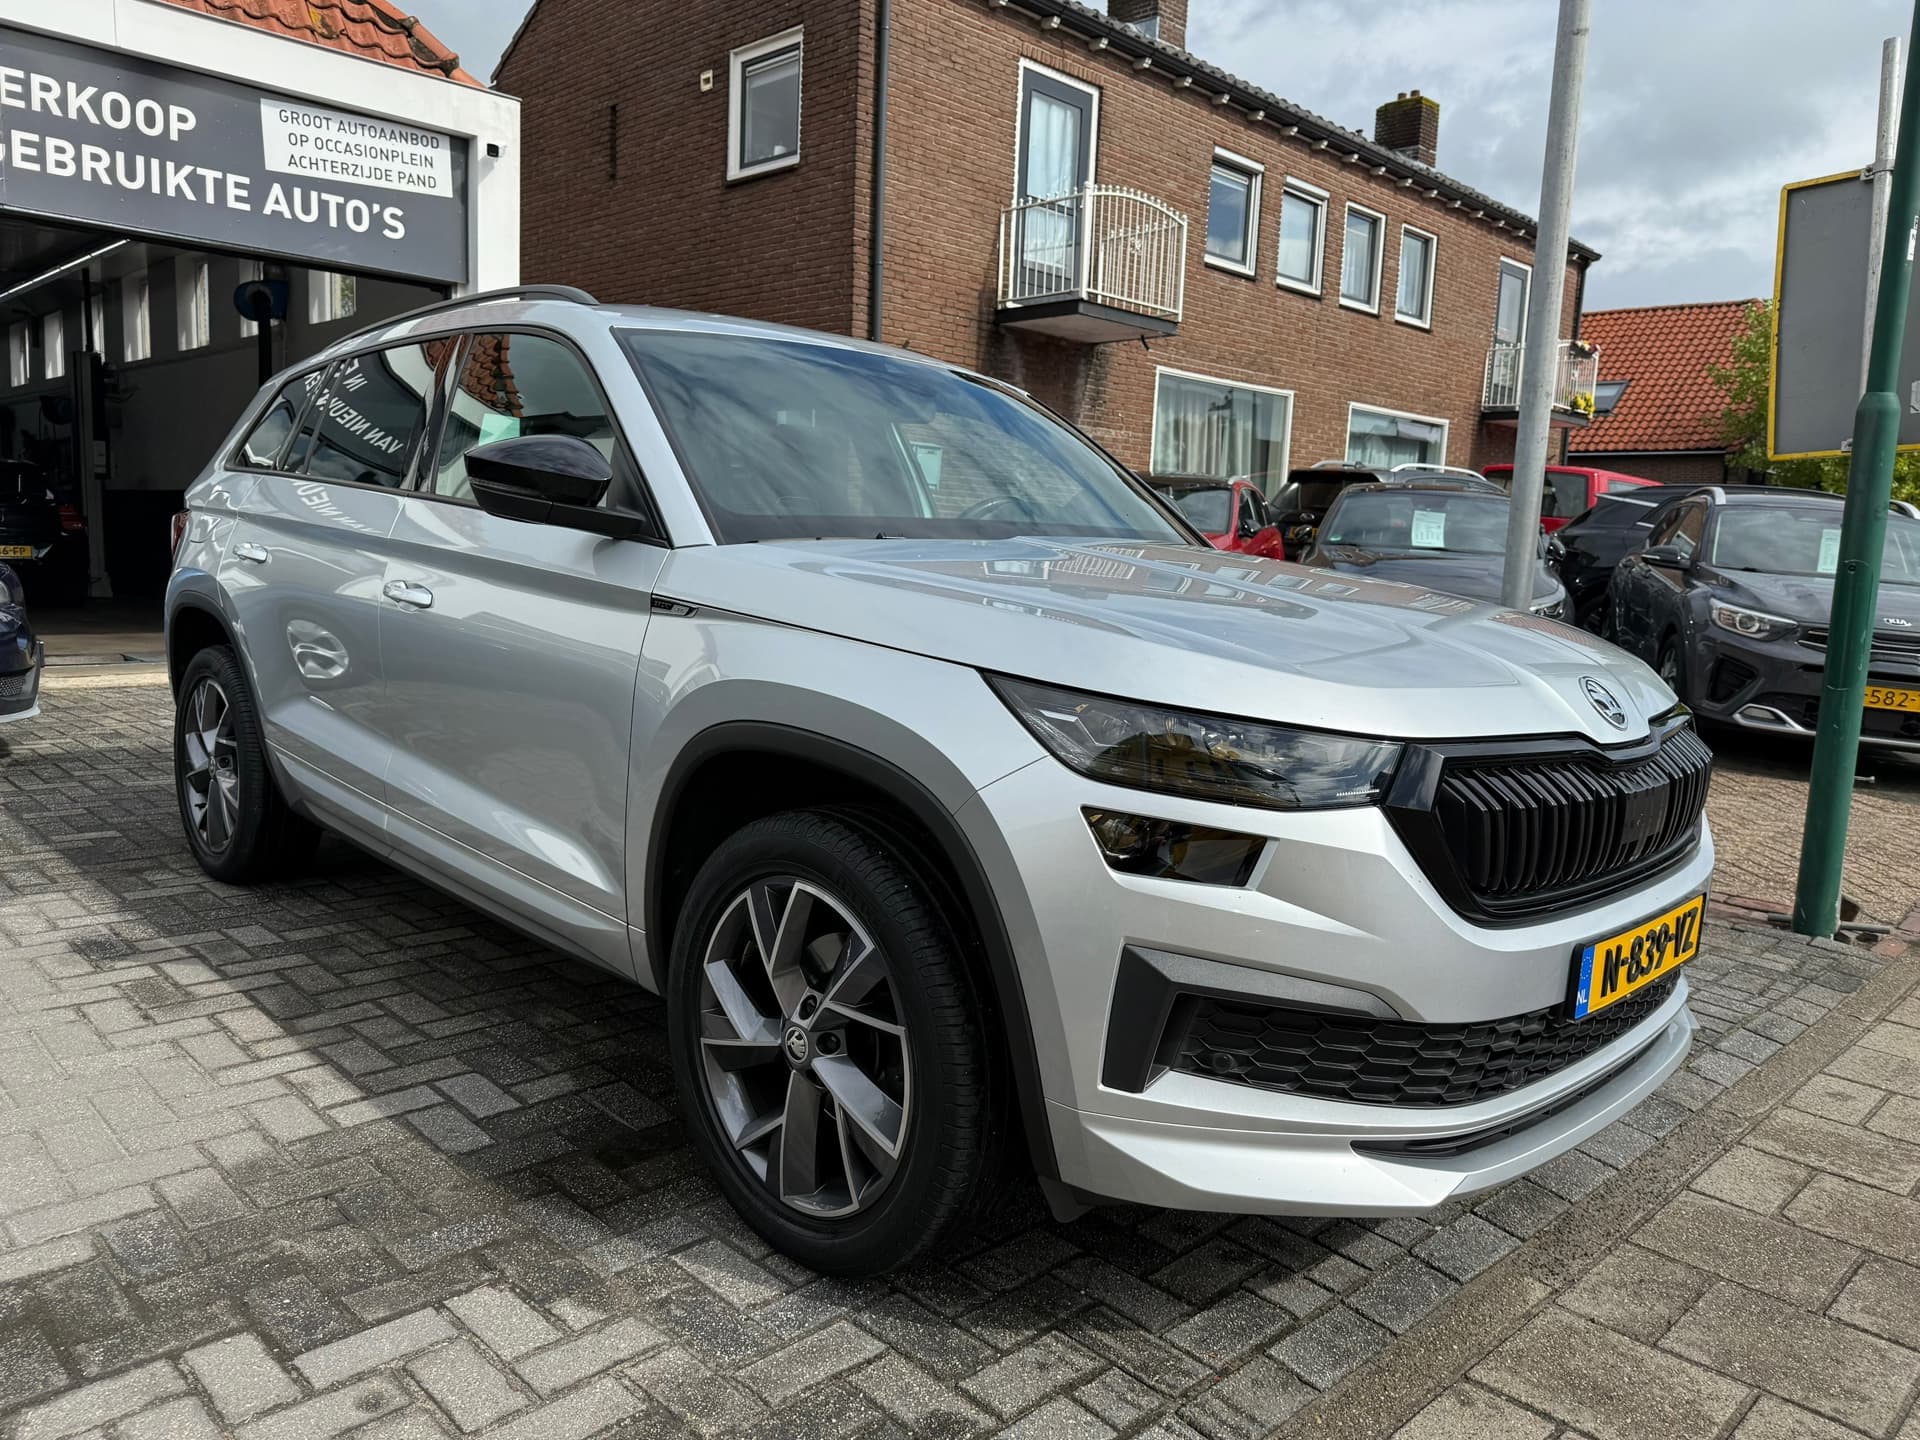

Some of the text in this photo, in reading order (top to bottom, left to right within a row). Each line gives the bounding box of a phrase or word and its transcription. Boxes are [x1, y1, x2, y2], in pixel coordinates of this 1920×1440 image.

[279, 109, 439, 149] GROOT AUTOAANBOD
[288, 132, 434, 168] OP OCCASIONPLEIN
[0, 129, 406, 240] EBRUIKTE AUTO'S
[288, 154, 437, 189] ACHTERZIJDE PAND
[0, 547, 26, 556] 6-FP
[1864, 690, 1920, 707] -582-
[1600, 906, 1699, 998] N-839-VZ
[1577, 989, 1588, 1006] NL
